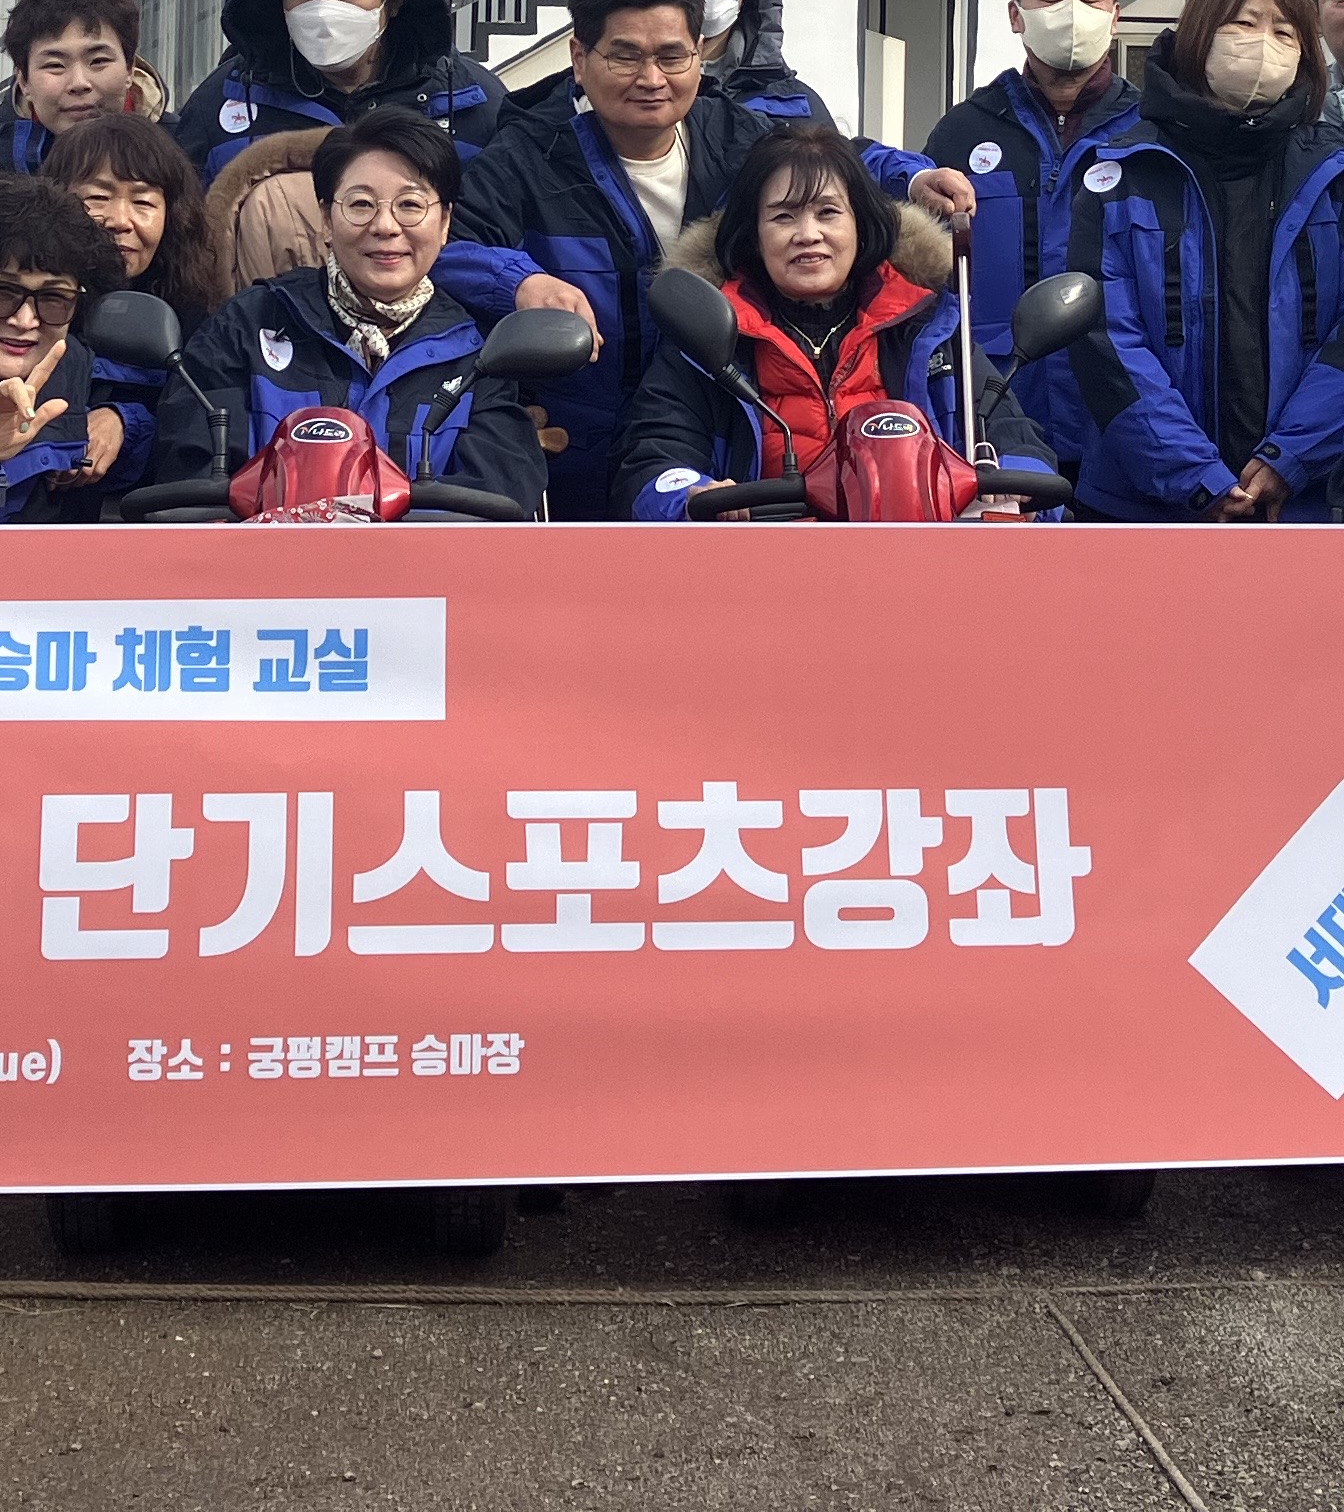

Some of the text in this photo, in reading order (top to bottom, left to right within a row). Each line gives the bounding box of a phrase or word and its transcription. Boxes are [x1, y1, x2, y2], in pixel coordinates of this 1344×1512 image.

[112, 624, 232, 693] 체험
[252, 628, 370, 693] 교실
[38, 781, 1092, 961] 단기스포츠강좌
[127, 1038, 205, 1081] 장소
[247, 1035, 400, 1079] 궁평캠프
[411, 1033, 525, 1076] 승마장
